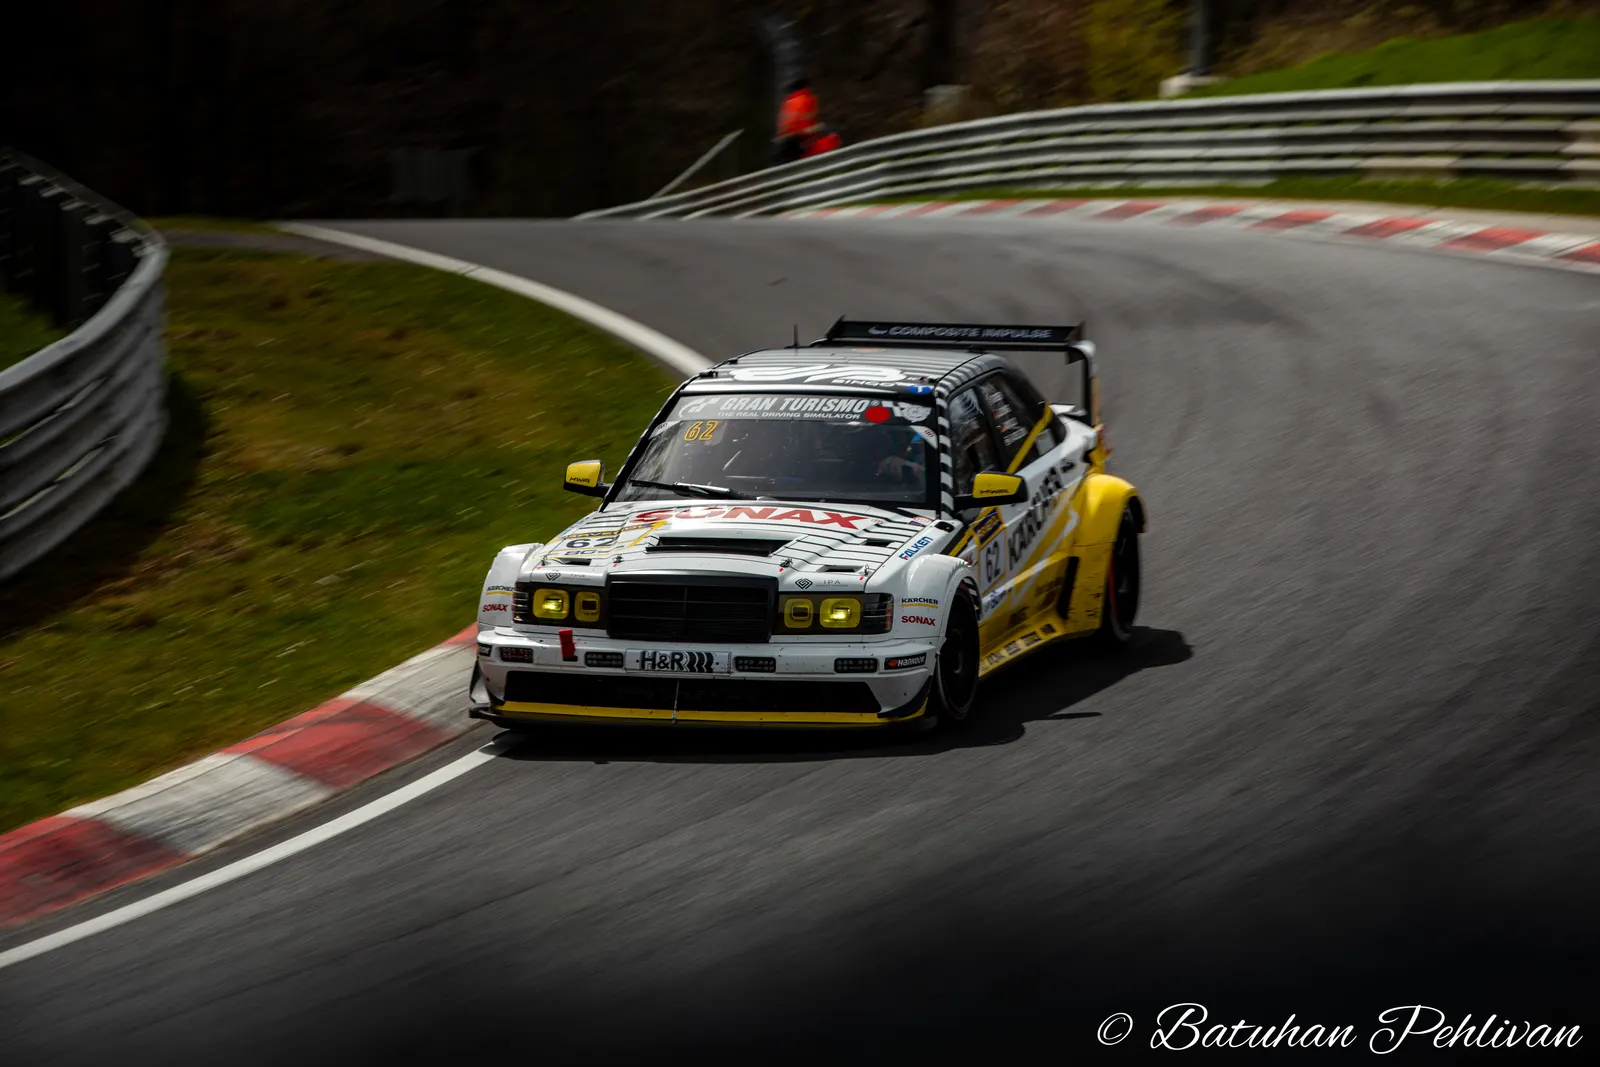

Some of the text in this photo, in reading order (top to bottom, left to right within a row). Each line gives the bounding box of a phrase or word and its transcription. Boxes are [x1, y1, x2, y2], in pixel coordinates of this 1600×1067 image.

[889, 326, 1053, 339] COMPOSITE IMPULSE
[719, 397, 778, 411] GRAN
[684, 420, 719, 441] 62
[566, 537, 619, 548] 62
[899, 536, 934, 560] FALKEN
[985, 541, 1001, 583] 62
[482, 603, 508, 612] SONAX
[901, 615, 936, 626] SONAX
[641, 650, 684, 671] H&R
